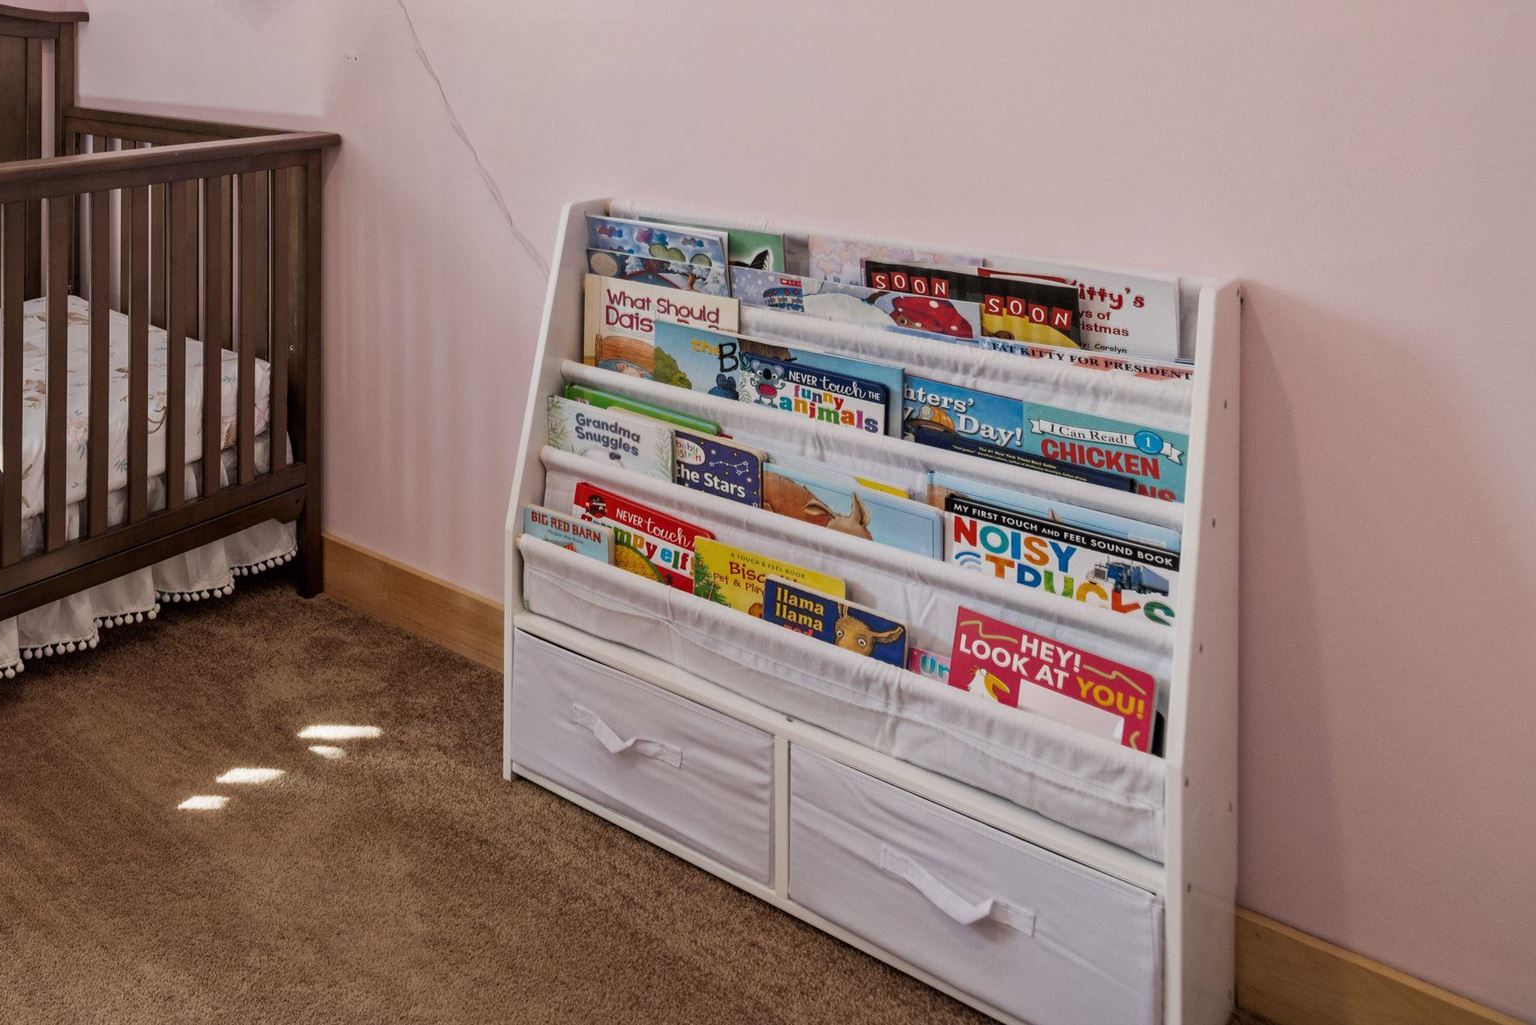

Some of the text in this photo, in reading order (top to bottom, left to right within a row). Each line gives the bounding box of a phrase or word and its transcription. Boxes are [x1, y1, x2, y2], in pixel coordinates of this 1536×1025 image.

[875, 274, 947, 297] SOON
[1072, 280, 1145, 310] itty's
[605, 305, 656, 333] Dais
[606, 288, 720, 324] What Should
[988, 297, 1068, 326] SOON
[1096, 311, 1112, 320] of
[1079, 321, 1129, 336] istmas
[992, 342, 1195, 381] FAT KITTY FOR PRESIDENT
[1094, 343, 1127, 354] Carolyn
[788, 370, 881, 401] NEVER touch THE
[794, 384, 844, 411] funny
[904, 383, 975, 413] hters'
[575, 412, 641, 443] Grandma
[779, 395, 879, 433] animals
[574, 426, 640, 456] Snuggles
[956, 412, 1023, 447] Day!
[1059, 425, 1086, 439] Can
[1090, 430, 1128, 444] Read!
[1145, 437, 1151, 448] 1
[1040, 438, 1160, 480] CHICKEN
[676, 464, 746, 498] the Stars
[531, 511, 548, 526] BIG
[550, 516, 571, 533] RED
[572, 523, 602, 544] BARN
[615, 507, 644, 528] NEVER
[644, 517, 691, 548] touch
[953, 503, 1173, 567] MY FIRST TOUCH AND FEEL SOUND BOOK
[953, 515, 1077, 573] NOISY
[713, 572, 729, 585] Pet
[733, 580, 742, 588] &
[737, 554, 760, 565] TOUCH
[767, 563, 784, 572] FEEL
[785, 568, 805, 578] BOOK
[776, 587, 825, 616] llama
[775, 602, 824, 632] llama
[1020, 634, 1082, 673] HEY!
[959, 633, 1031, 677] LOOK
[1034, 663, 1070, 689] AT
[1075, 675, 1146, 720] YOU!
